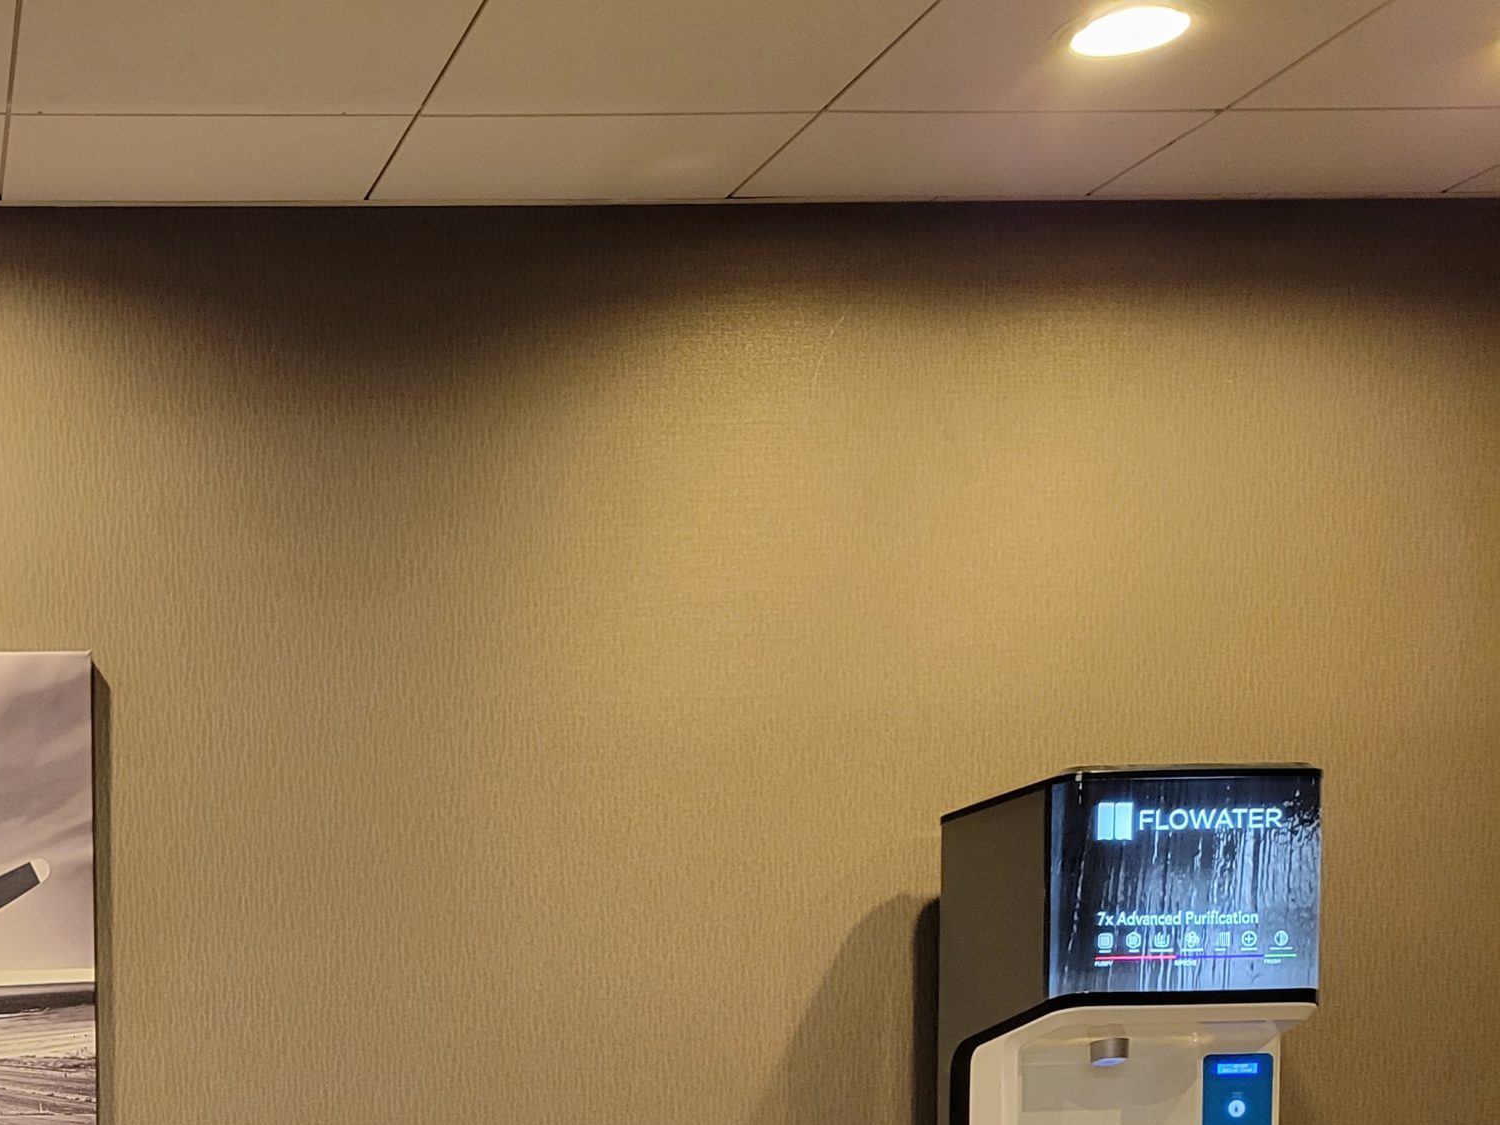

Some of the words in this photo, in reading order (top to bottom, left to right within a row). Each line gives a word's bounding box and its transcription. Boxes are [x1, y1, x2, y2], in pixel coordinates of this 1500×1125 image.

[1139, 808, 1283, 830] FLOWATER
[1097, 912, 1114, 926] 7x
[1117, 911, 1181, 926] Advanced
[1185, 911, 1259, 926] Purification
